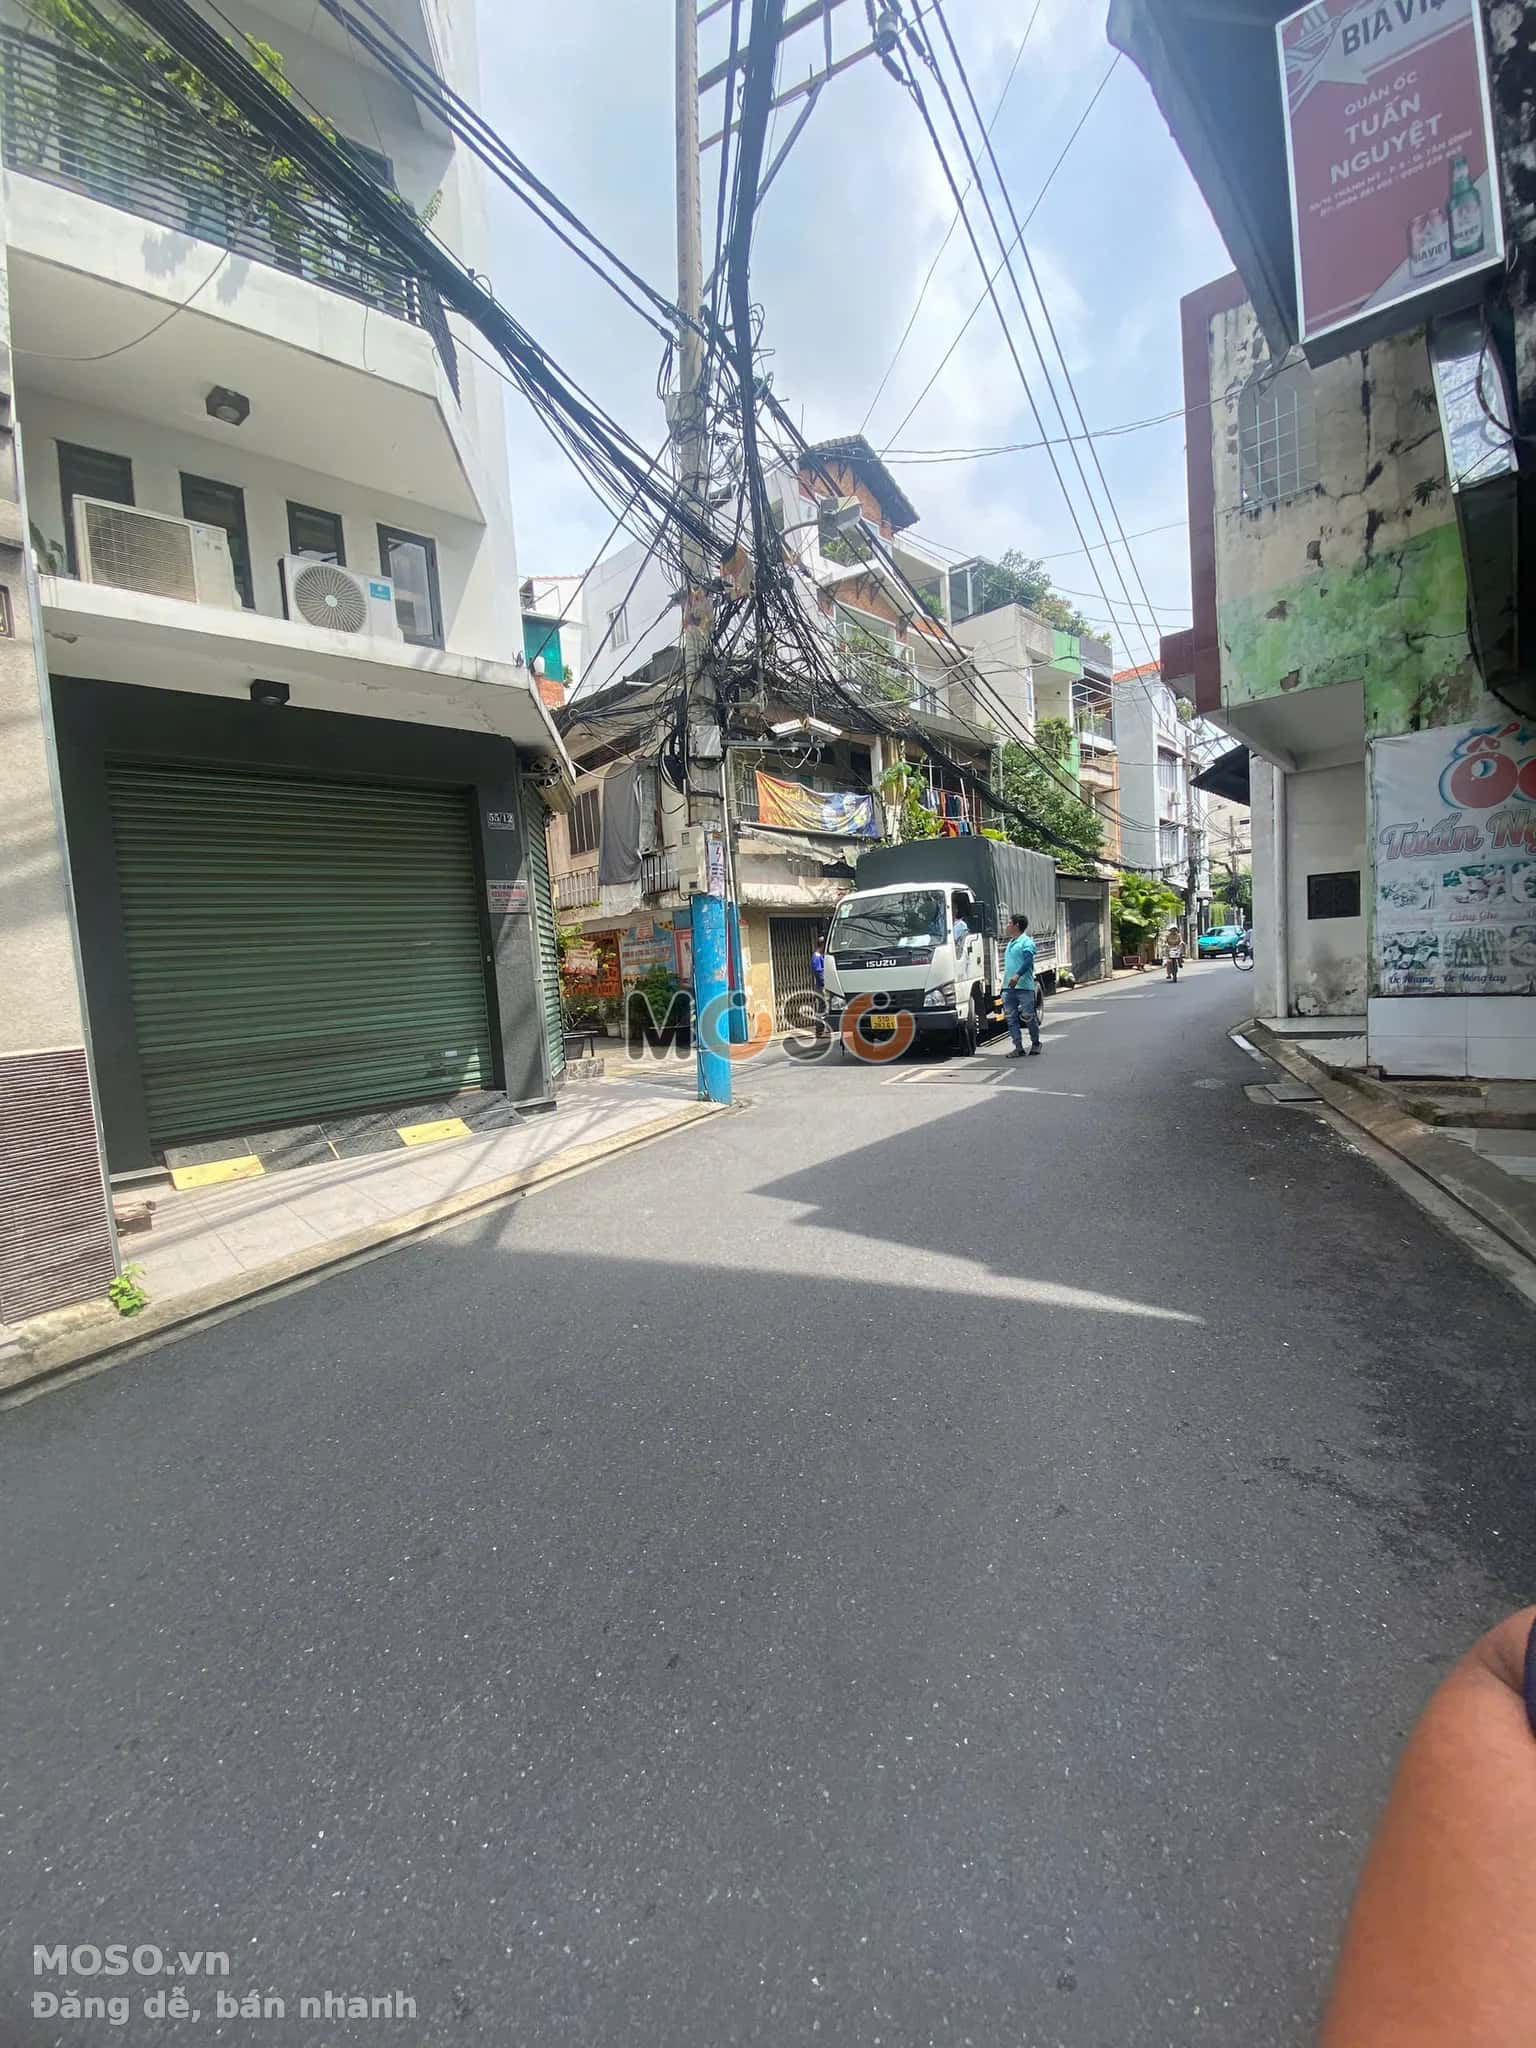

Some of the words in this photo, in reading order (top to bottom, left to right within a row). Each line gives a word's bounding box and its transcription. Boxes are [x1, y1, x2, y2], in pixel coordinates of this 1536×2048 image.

[1342, 8, 1393, 56] BIA
[1344, 92, 1421, 145] TUẤN
[1331, 112, 1443, 185] NGUYỆT
[1440, 722, 1536, 809] Ố
[488, 812, 513, 823] 55/12
[866, 959, 897, 968] ISUZU
